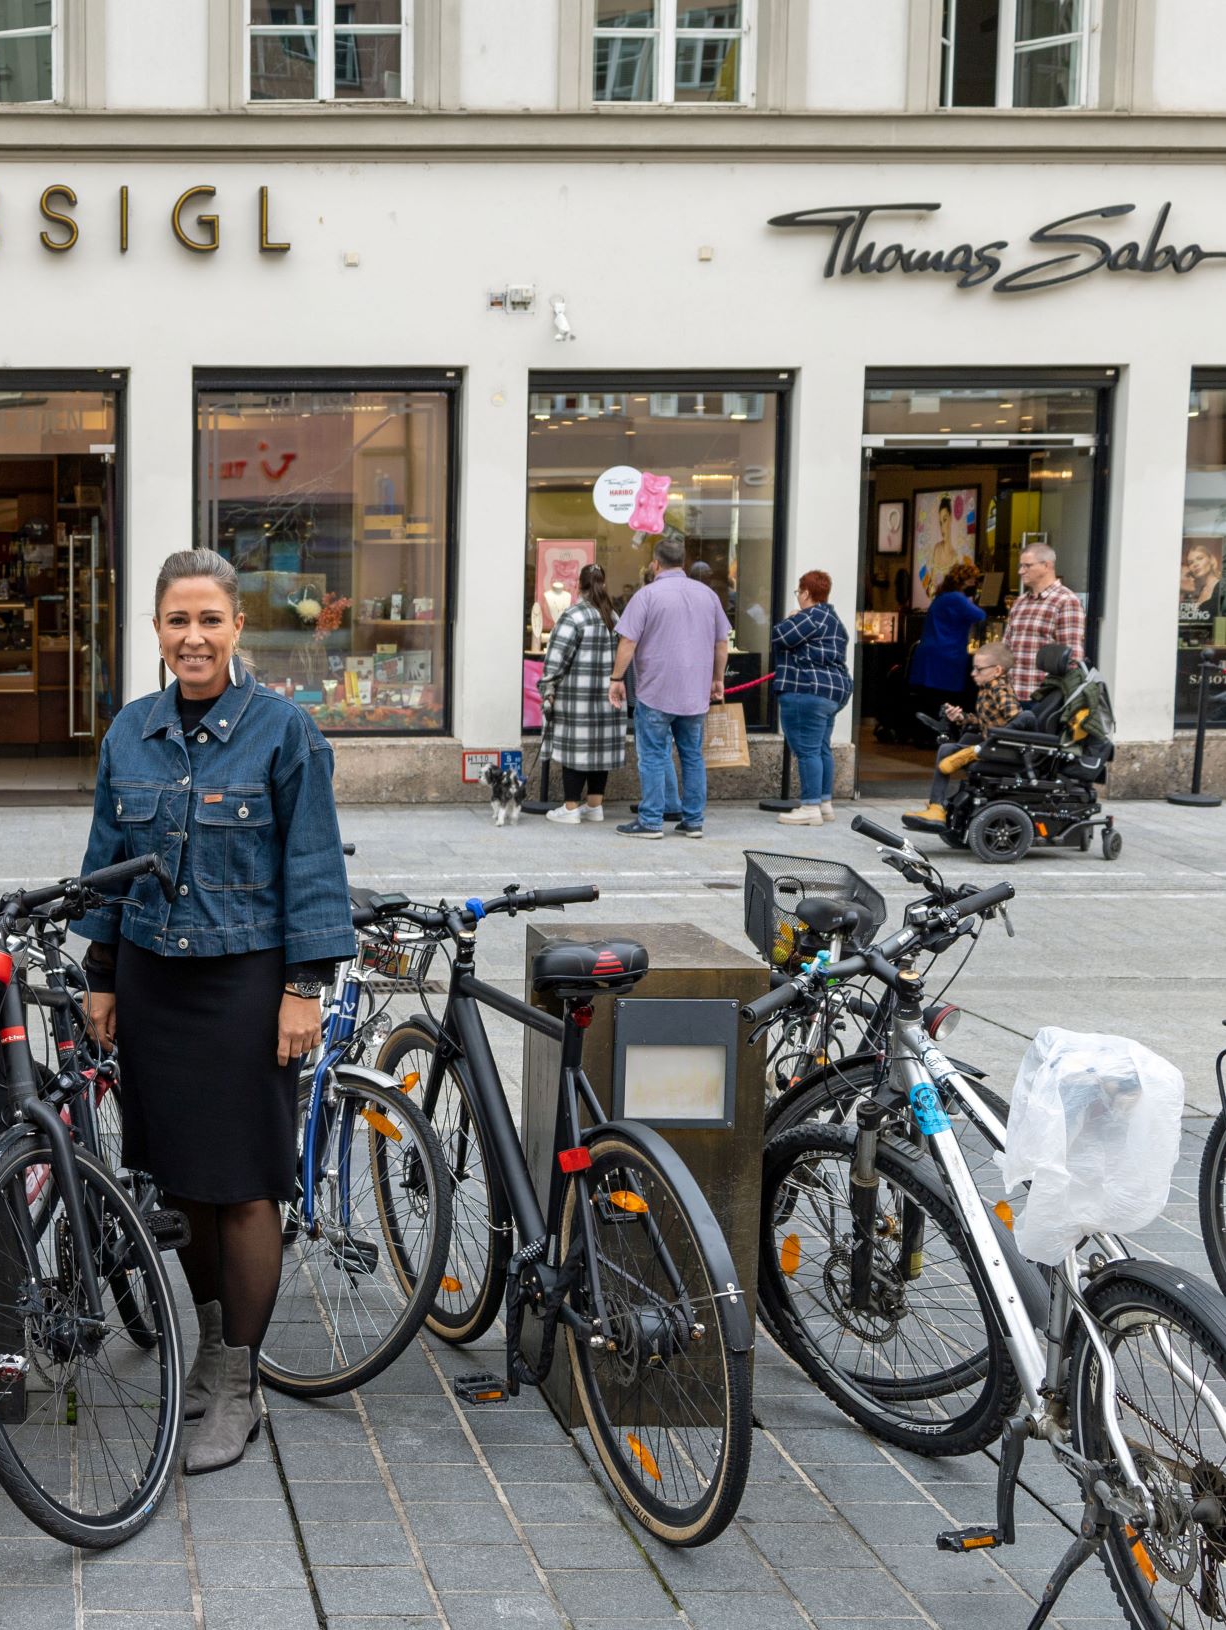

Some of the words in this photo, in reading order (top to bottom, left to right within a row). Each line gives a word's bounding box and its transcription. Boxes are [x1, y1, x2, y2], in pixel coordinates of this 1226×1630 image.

[767, 202, 1008, 288] Thomas
[993, 201, 1226, 293] Sabo
[609, 488, 633, 497] HARIBO
